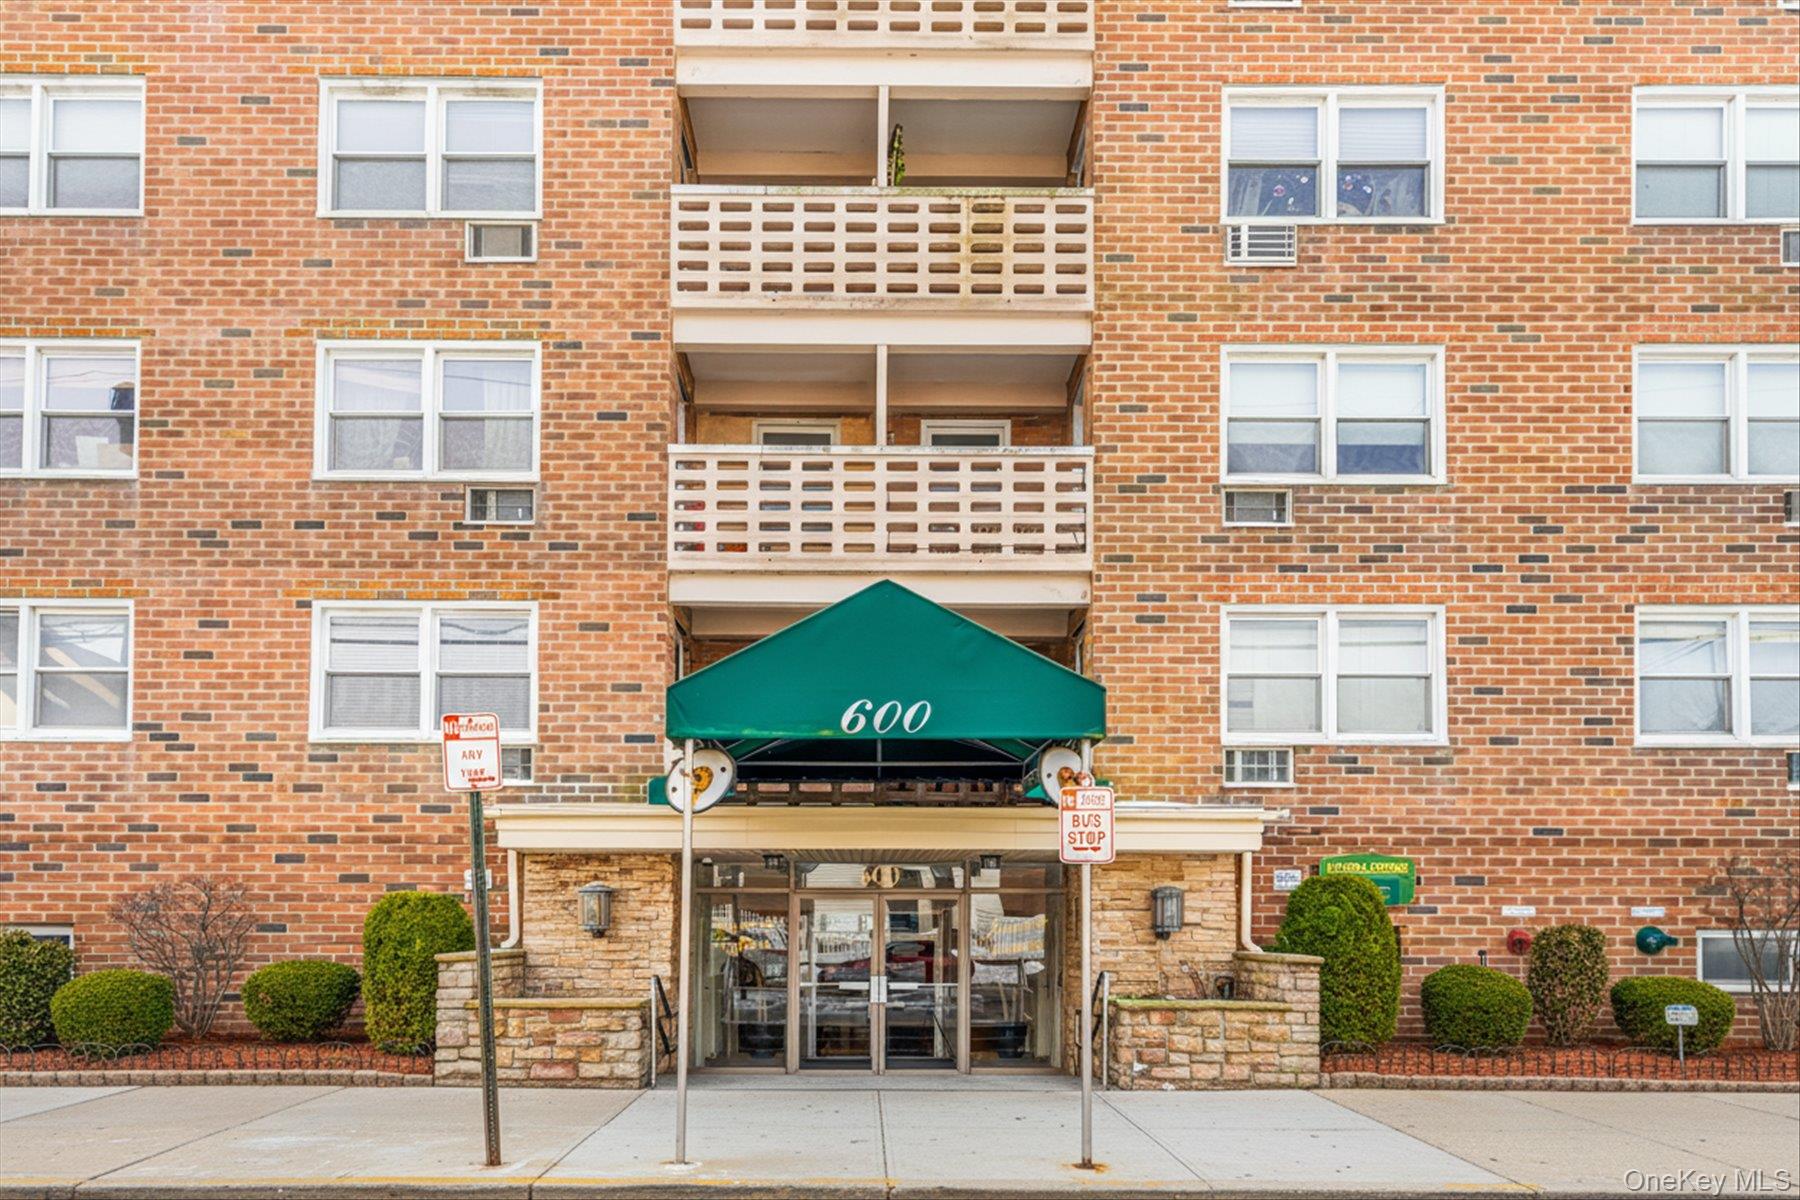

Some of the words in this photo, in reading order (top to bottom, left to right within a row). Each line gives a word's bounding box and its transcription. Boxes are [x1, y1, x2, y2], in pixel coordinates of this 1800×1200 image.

[840, 698, 932, 734] 600
[1072, 814, 1102, 828] BUS
[1067, 831, 1106, 845] STOP
